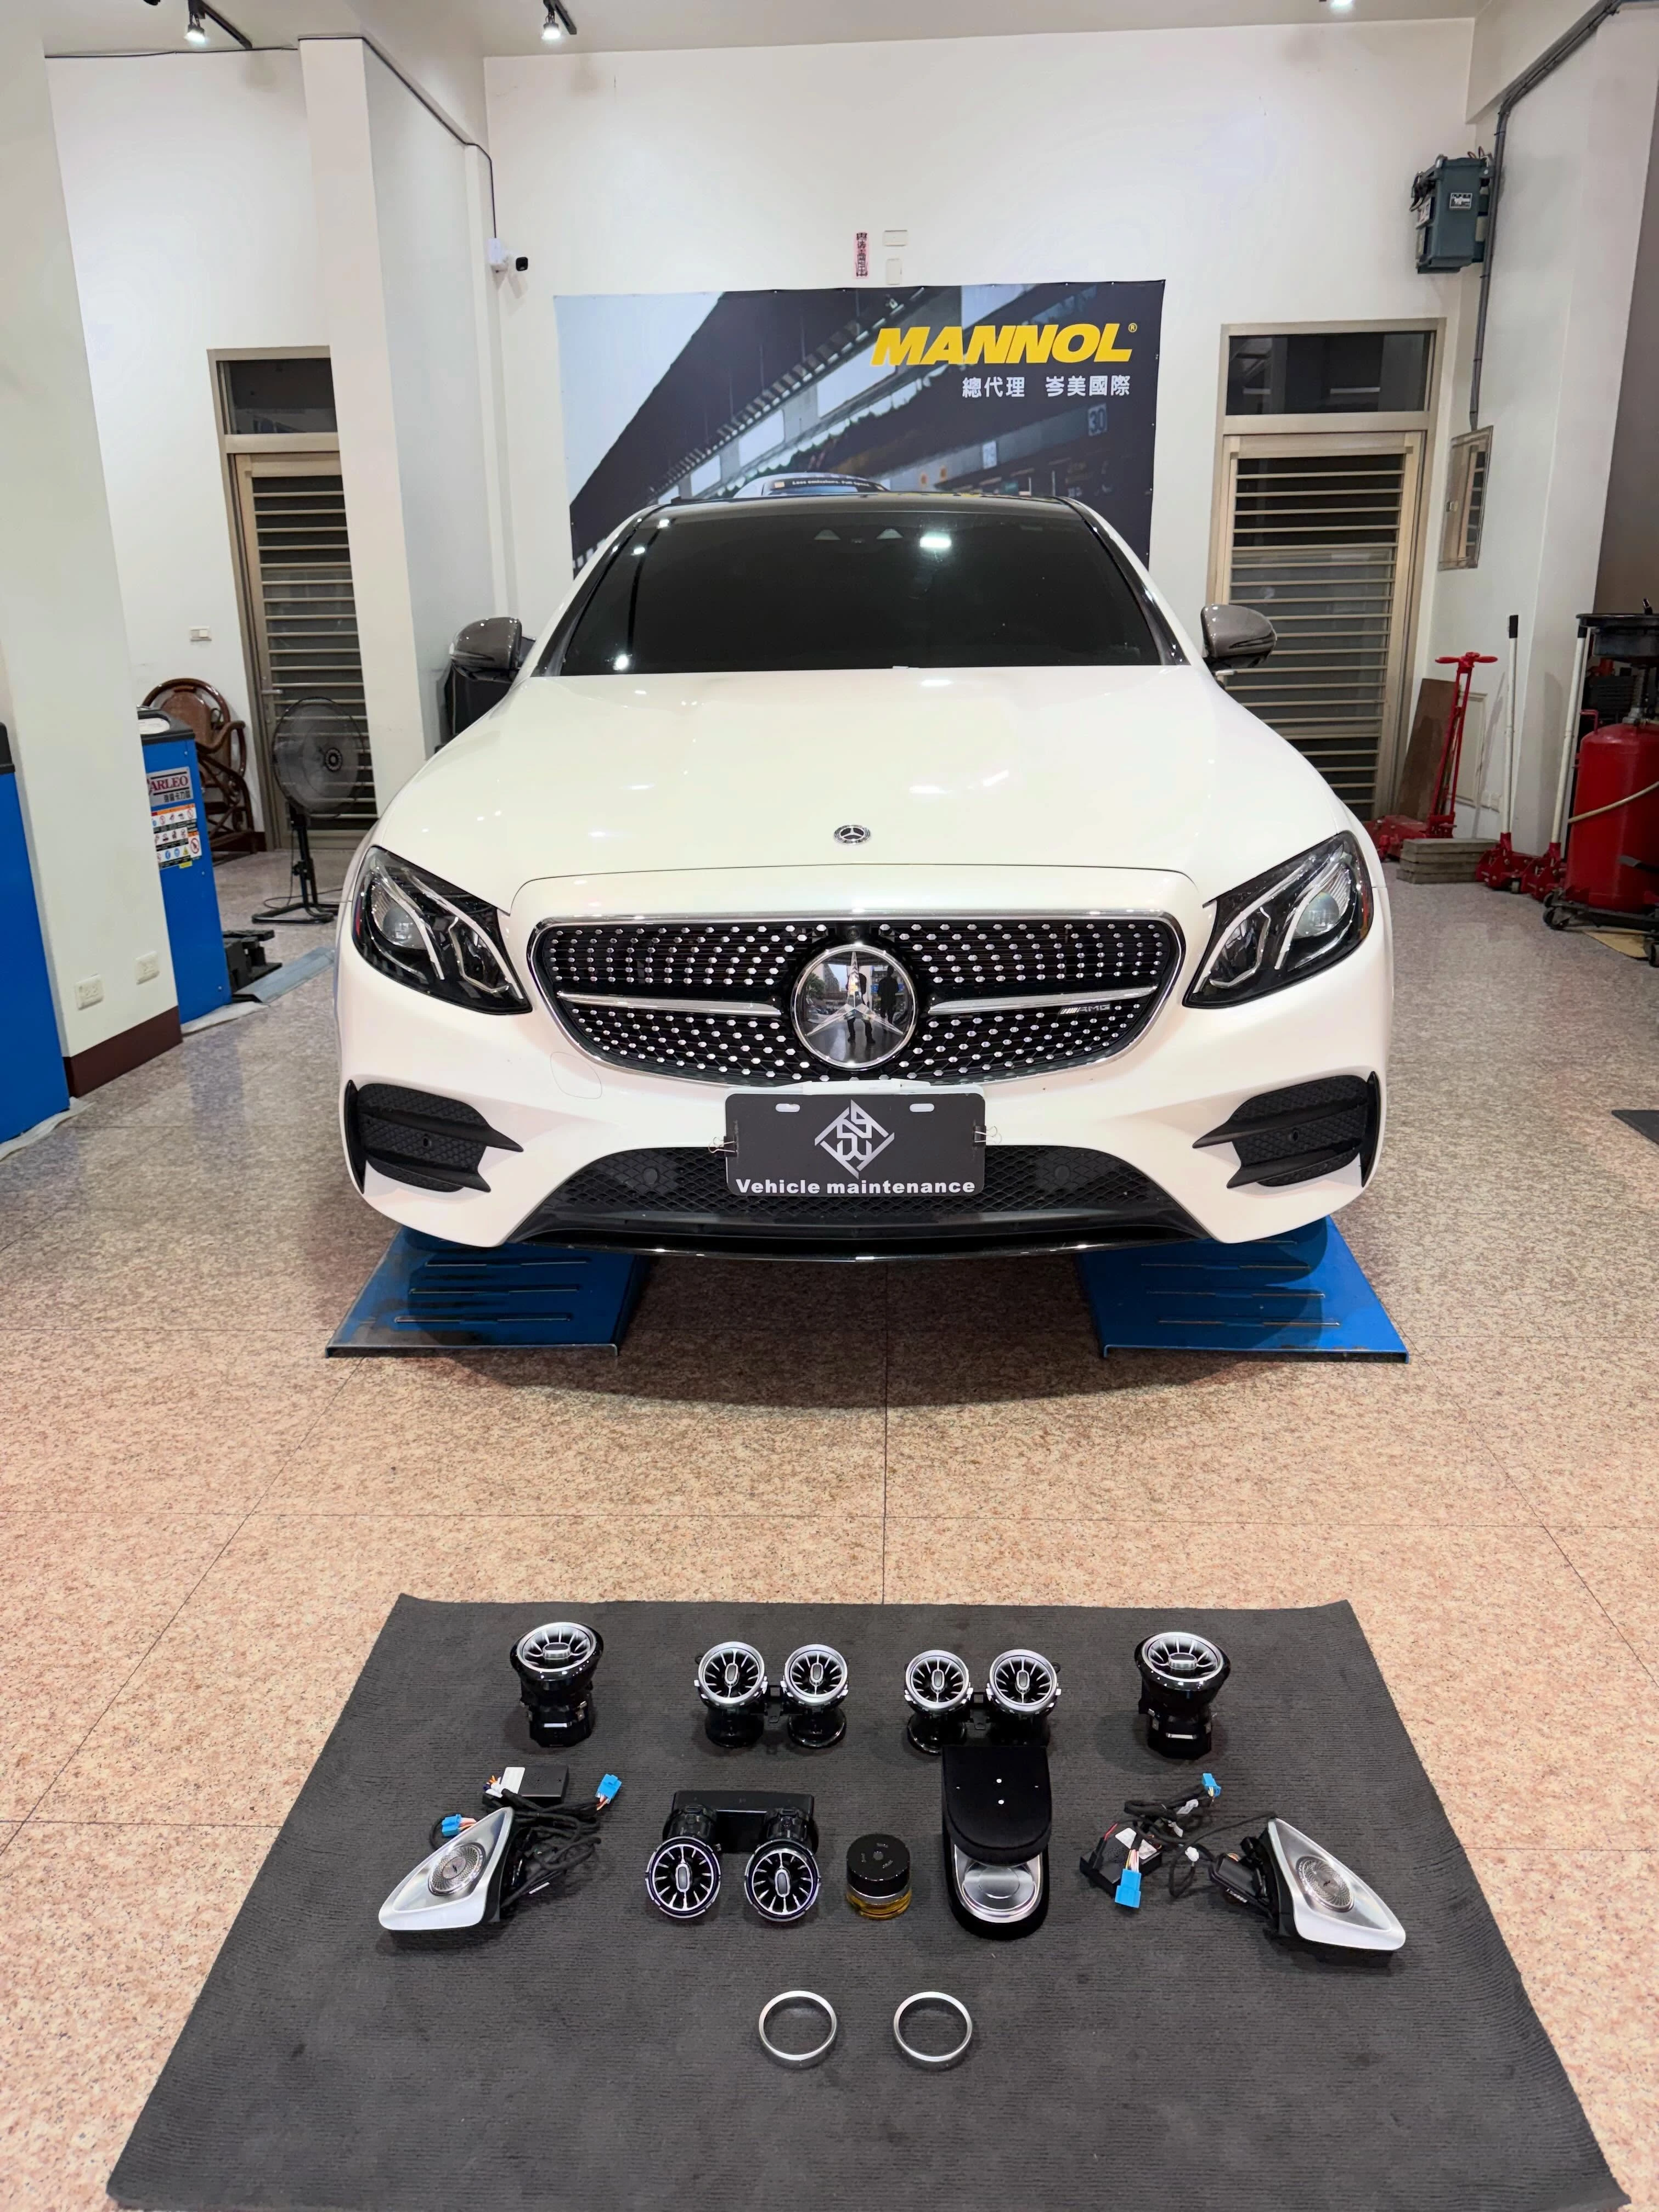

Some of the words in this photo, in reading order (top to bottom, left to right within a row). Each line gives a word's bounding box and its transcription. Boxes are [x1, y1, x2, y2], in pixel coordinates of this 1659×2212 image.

[962, 376, 1026, 398] 總代理
[1045, 375, 1131, 397] 岑美國際
[1090, 408, 1106, 433] 30
[736, 1178, 820, 1194] Vehicle
[826, 1179, 976, 1194] maintenance
